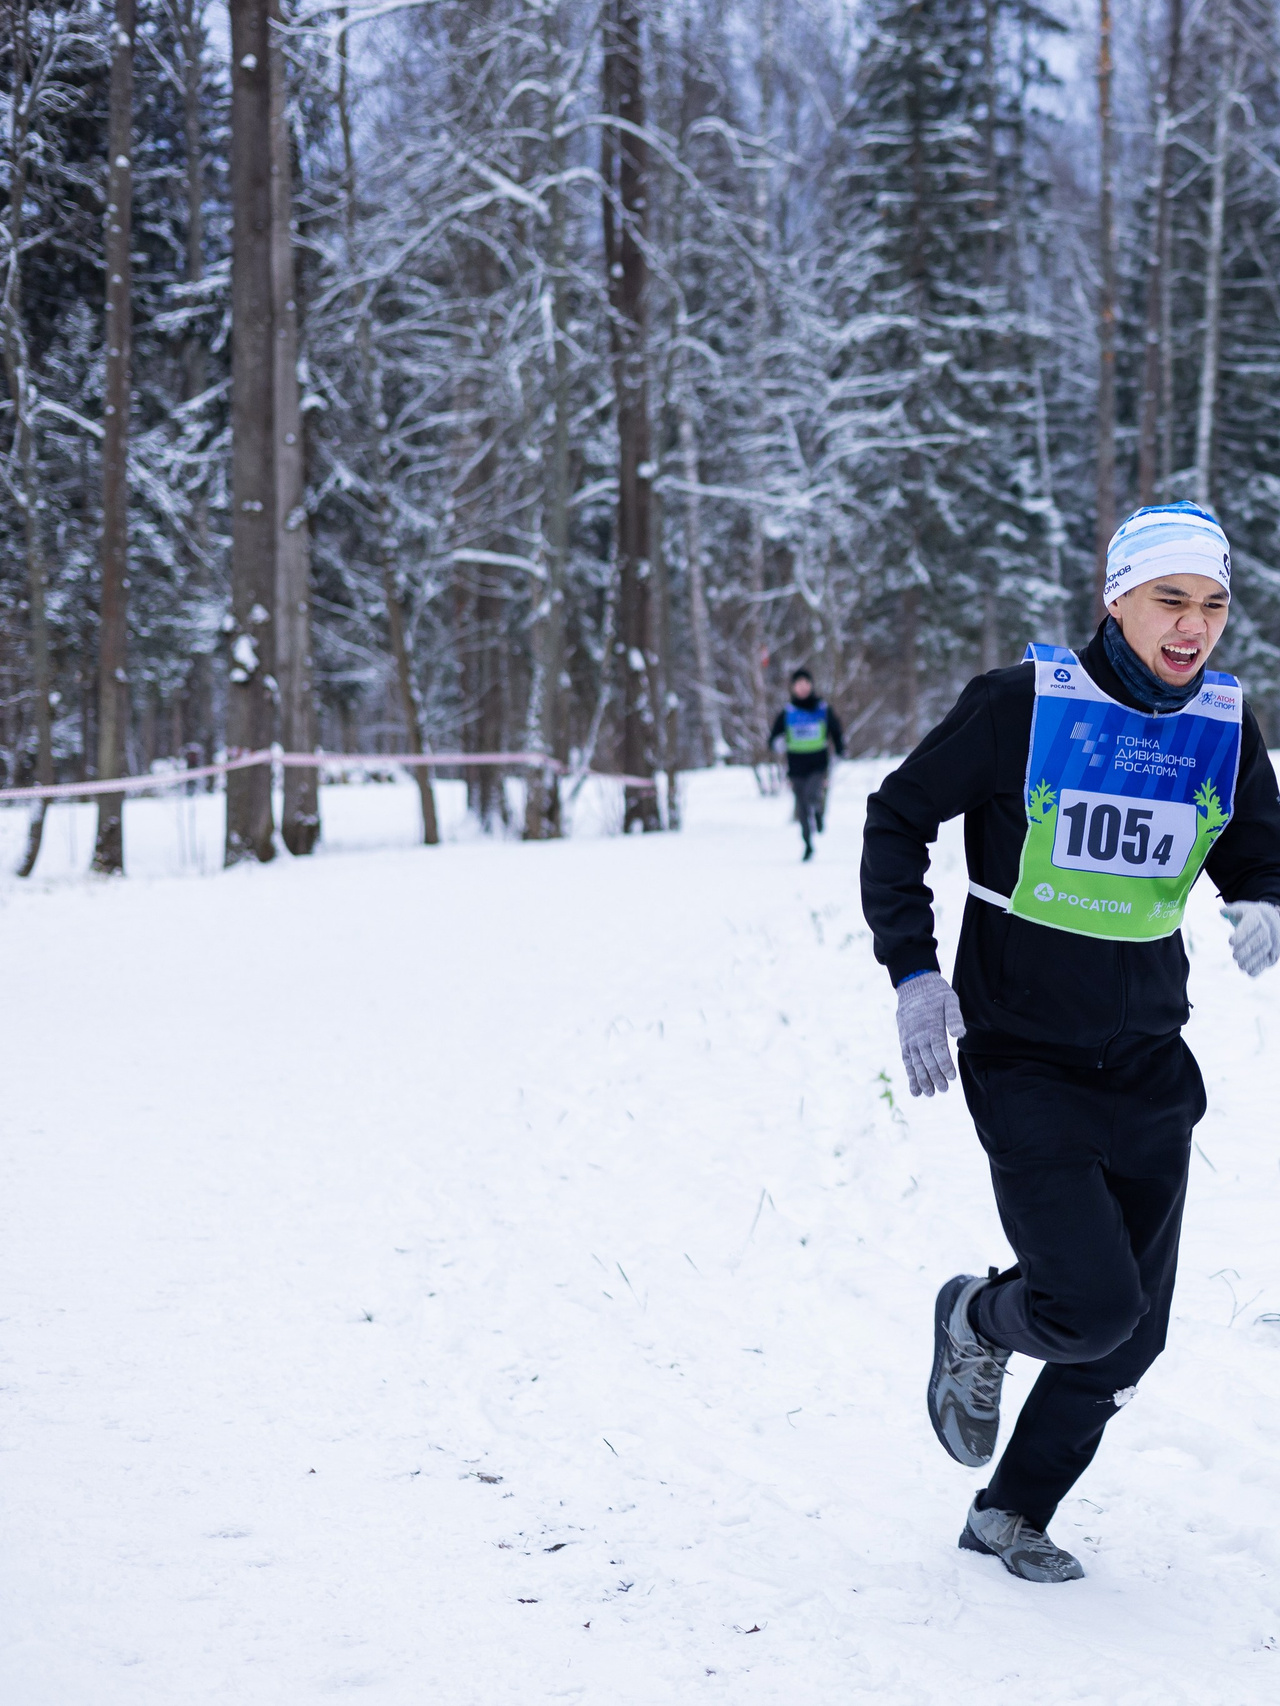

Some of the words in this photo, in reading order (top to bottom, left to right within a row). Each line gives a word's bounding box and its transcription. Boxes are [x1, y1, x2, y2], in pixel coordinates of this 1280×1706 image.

[1213, 701, 1236, 711] СПОРТ
[1216, 695, 1236, 704] АТОМ
[1116, 735, 1161, 750] ГОНКА
[1114, 748, 1197, 769] ДИВИЗИОНОВ
[1114, 760, 1178, 778] РОСАТОМА
[1057, 892, 1132, 914] РОСАТОМ
